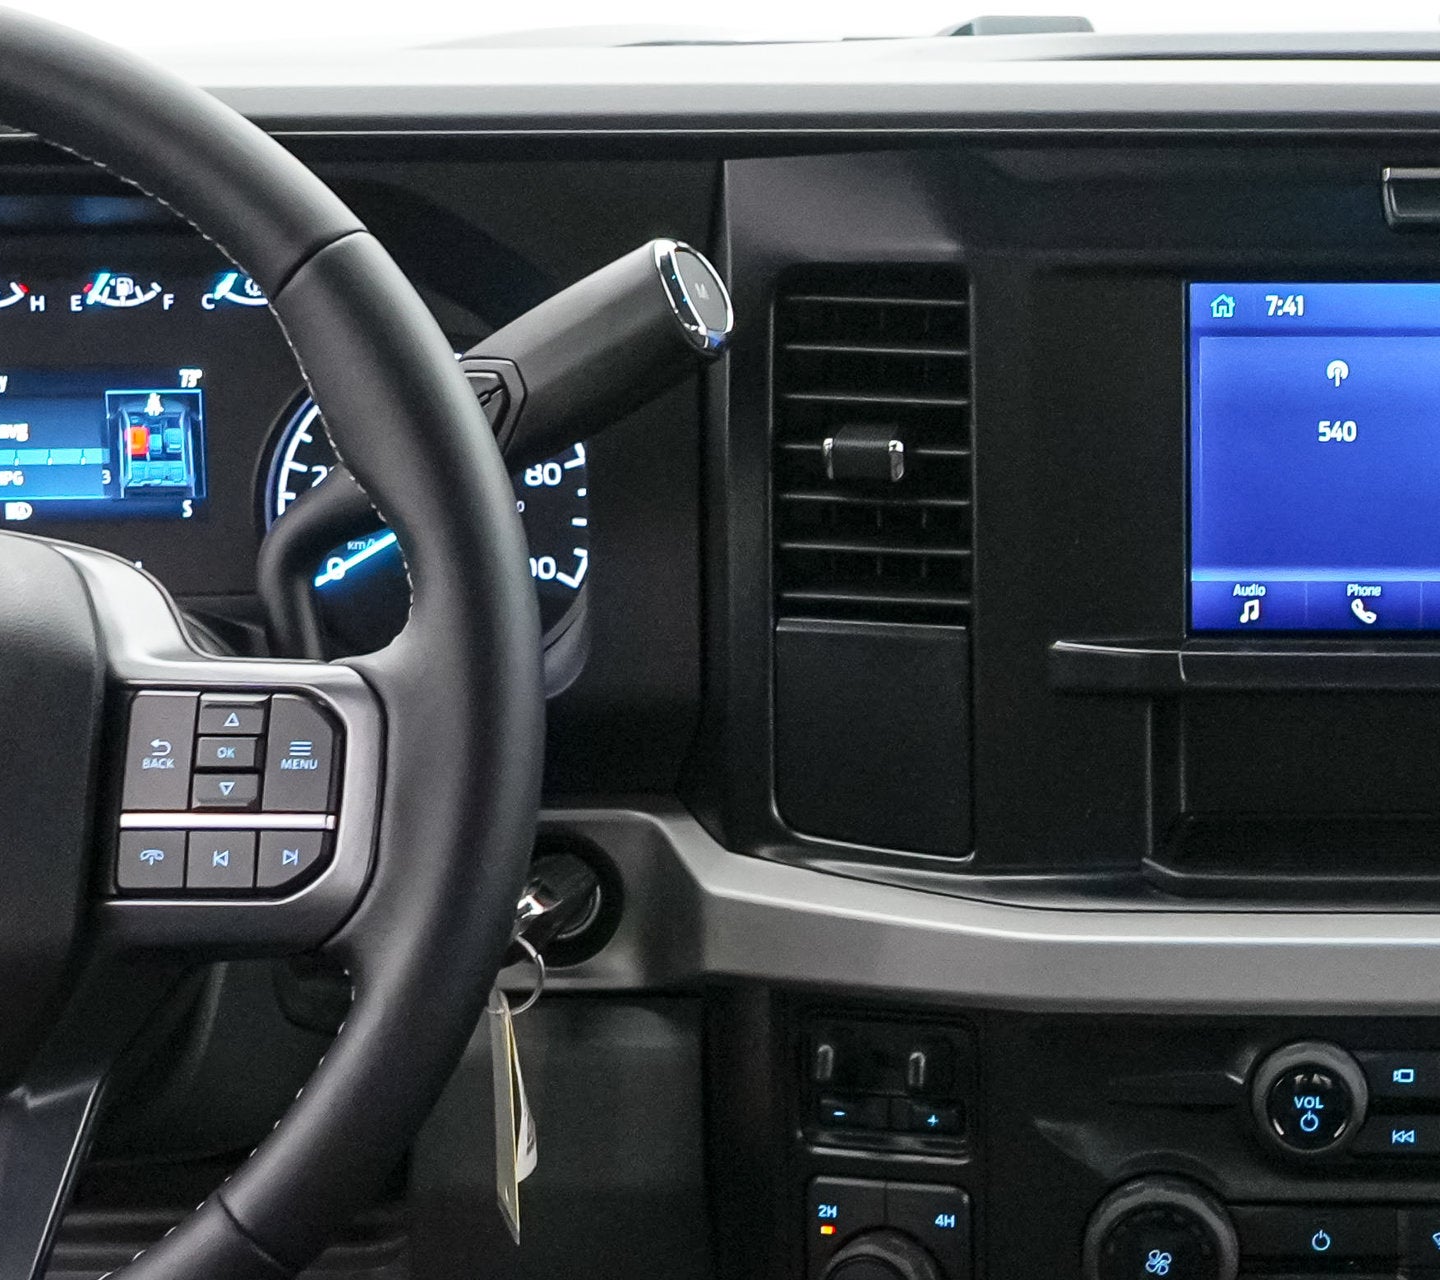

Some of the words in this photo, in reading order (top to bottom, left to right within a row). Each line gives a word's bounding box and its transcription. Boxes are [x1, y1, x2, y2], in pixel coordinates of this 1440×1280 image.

[30, 296, 45, 311] H
[70, 295, 83, 311] E
[163, 294, 174, 310] F
[202, 294, 215, 310] C
[1265, 295, 1304, 316] 7:41
[1318, 421, 1357, 442] 540
[1233, 583, 1266, 597] Audio
[1347, 583, 1381, 597] Phone
[217, 747, 236, 758] OK
[142, 758, 174, 769] BACK
[281, 758, 318, 770] MENU
[1293, 1096, 1324, 1109] VOL
[818, 1205, 837, 1218] 2H
[934, 1214, 955, 1228] 4H
